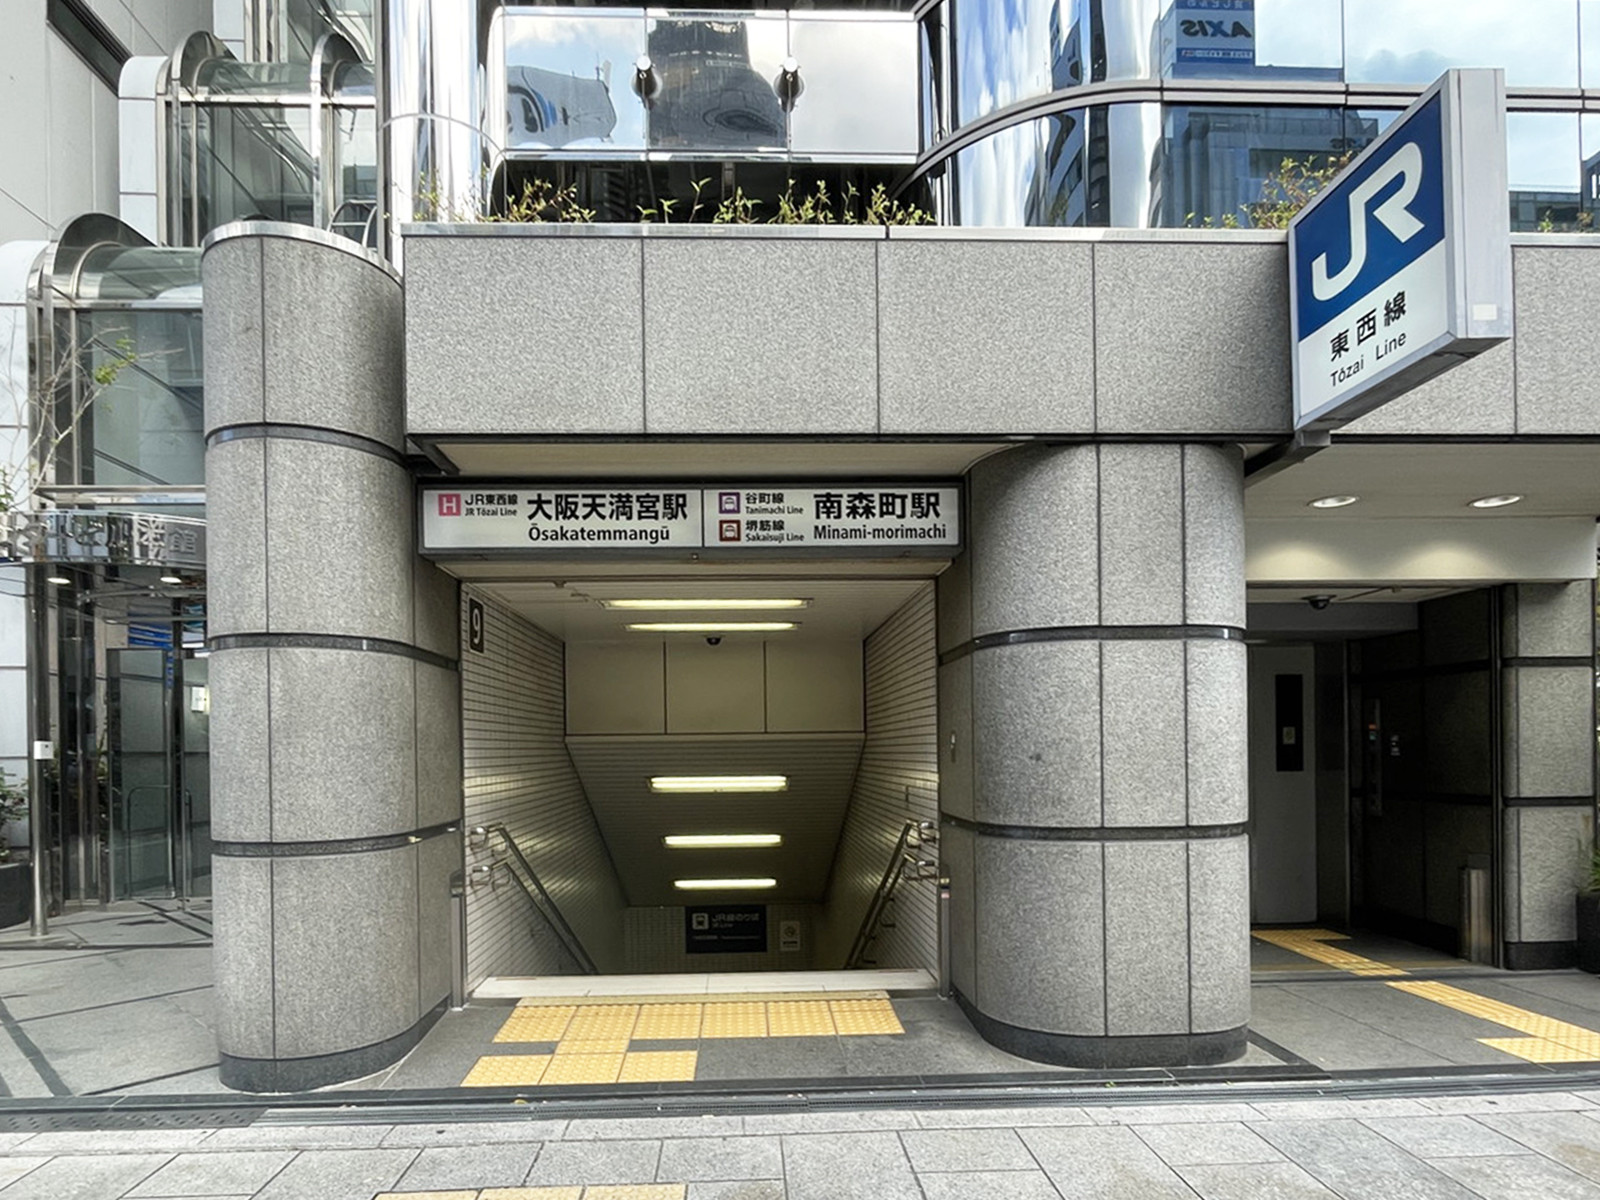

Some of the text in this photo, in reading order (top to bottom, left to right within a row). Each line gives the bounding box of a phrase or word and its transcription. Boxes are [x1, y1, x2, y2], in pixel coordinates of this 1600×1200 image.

[1311, 142, 1426, 301] JR
[1330, 290, 1407, 363] 東西線
[1376, 331, 1406, 361] Line
[464, 494, 518, 506] JR東西線
[526, 493, 688, 521] 大阪天満宮駅
[745, 492, 785, 504] 谷町線
[813, 492, 941, 520] 南森町駅
[465, 508, 475, 516] JR
[500, 507, 517, 516] Line
[745, 506, 804, 515] Tanimachi Line
[528, 523, 670, 544] Ōsakatemmangū
[745, 520, 785, 532] 堺筋線
[813, 523, 947, 540] Minami-morimachi
[745, 533, 805, 543] Sakaisuji Line
[473, 609, 481, 644] 9
